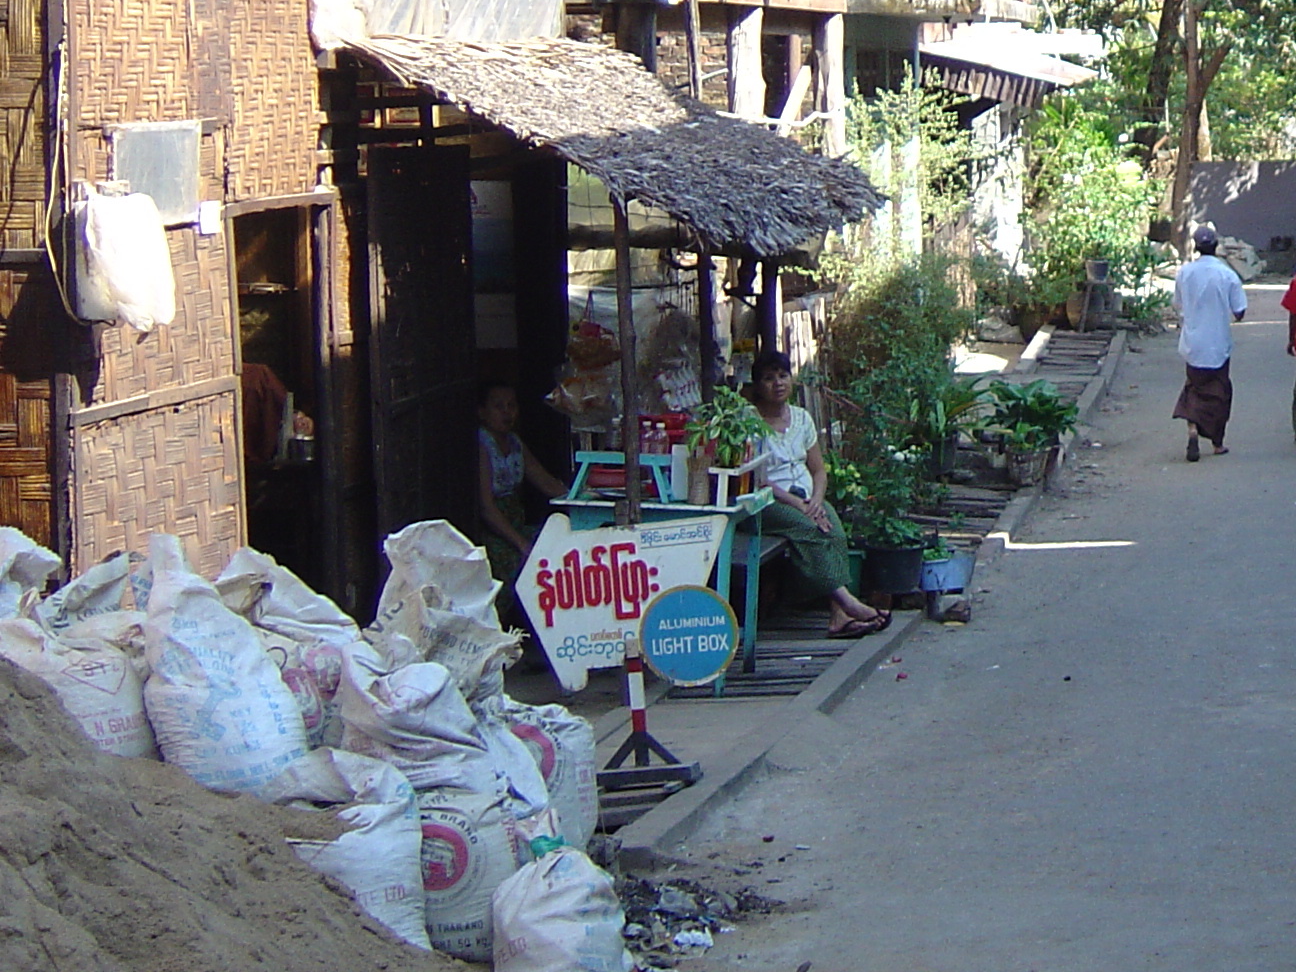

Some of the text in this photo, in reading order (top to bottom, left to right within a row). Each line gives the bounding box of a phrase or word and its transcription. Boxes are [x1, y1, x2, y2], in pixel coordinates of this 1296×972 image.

[536, 542, 660, 628] နံပါတ်ပြား
[658, 615, 725, 630] ALUMINIUM
[651, 633, 729, 656] LIGHT BOX
[439, 813, 479, 845] BRAND
